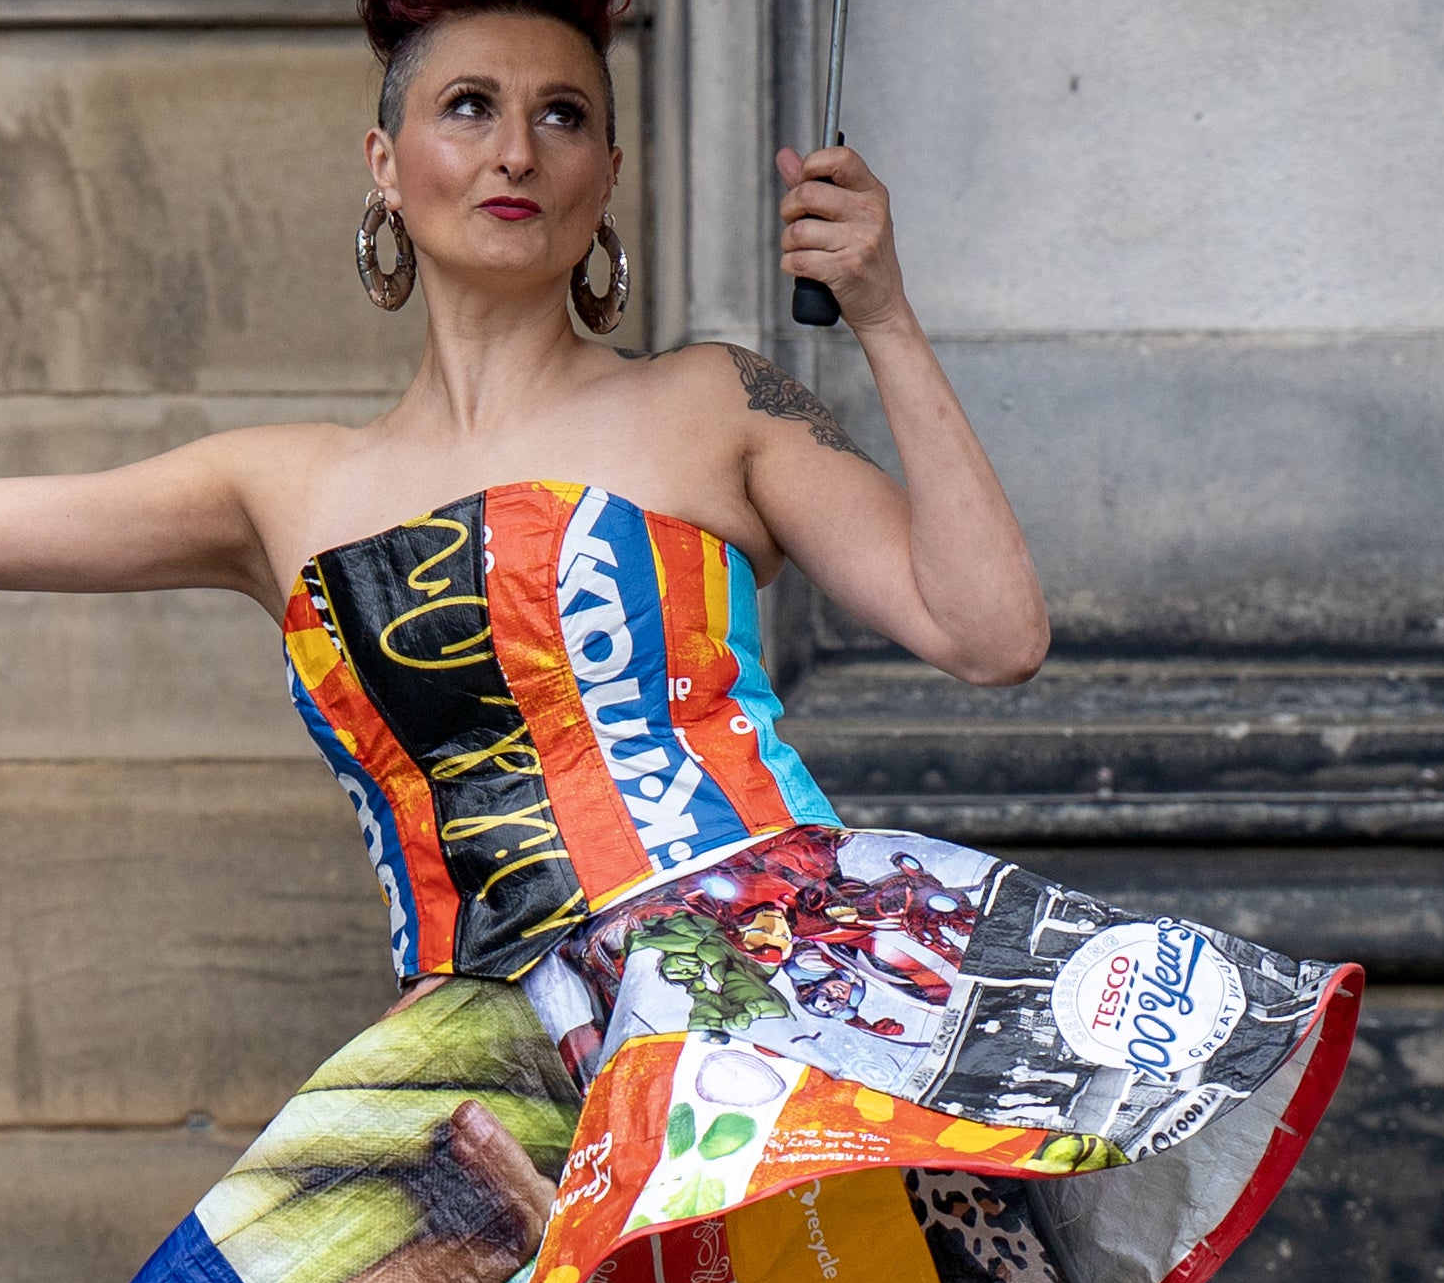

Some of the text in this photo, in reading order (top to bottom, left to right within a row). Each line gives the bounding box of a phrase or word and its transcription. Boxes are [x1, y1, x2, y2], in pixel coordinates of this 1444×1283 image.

[1092, 955, 1130, 1030] TESCO
[1125, 917, 1207, 1082] 100 Years
[1188, 1005, 1237, 1059] GREAT
[1168, 1103, 1204, 1140] FOOD
[804, 1208, 840, 1280] recycle
